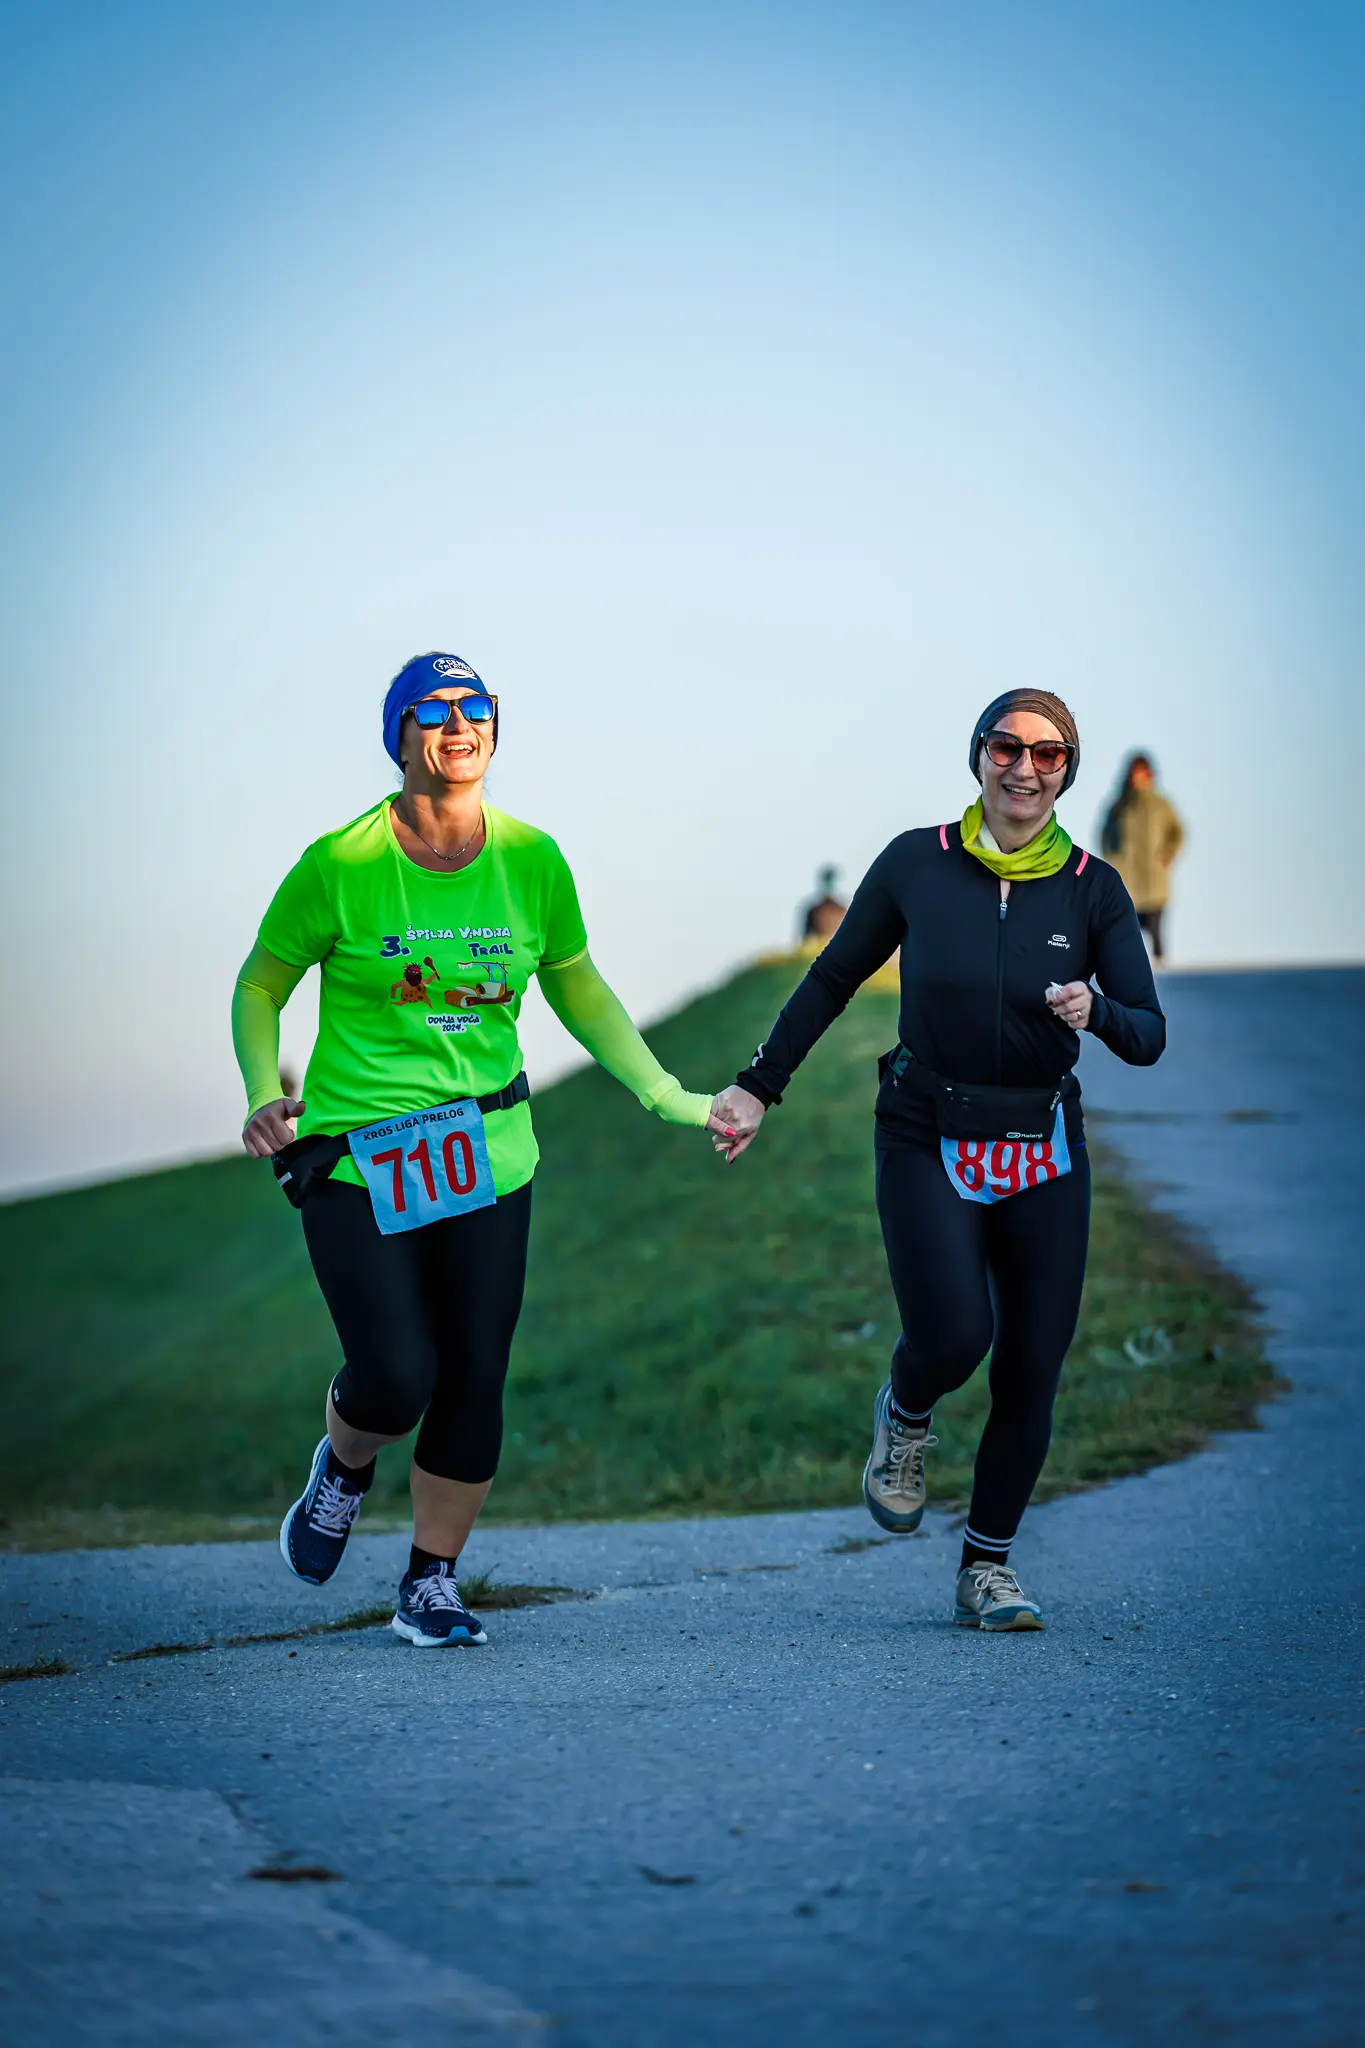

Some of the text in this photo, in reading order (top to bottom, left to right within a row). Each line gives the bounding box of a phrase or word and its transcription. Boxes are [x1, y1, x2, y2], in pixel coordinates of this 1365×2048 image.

[380, 935, 411, 958] 3.
[405, 925, 454, 941] ŠPILJA
[427, 1015, 455, 1024] DONJA
[363, 1107, 465, 1141] KROS LIGA PRELOG
[370, 1130, 477, 1213] 710
[955, 1140, 1058, 1196] 898
